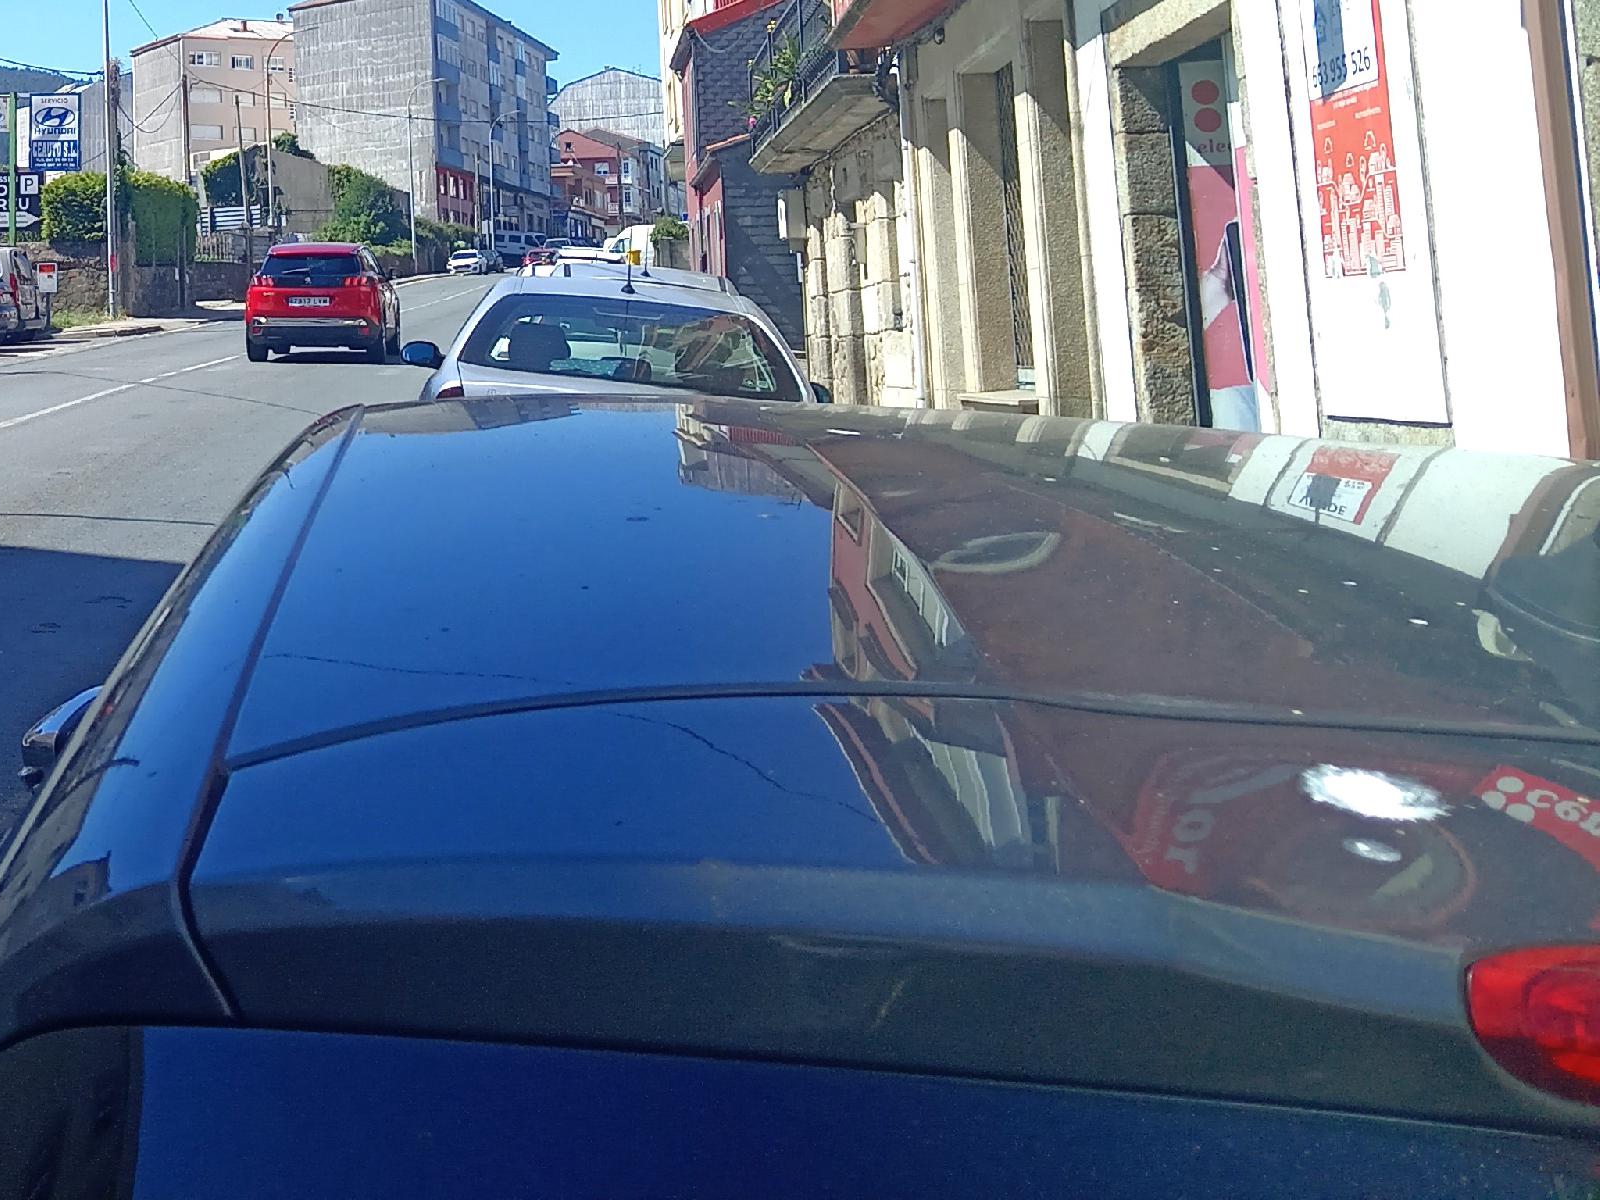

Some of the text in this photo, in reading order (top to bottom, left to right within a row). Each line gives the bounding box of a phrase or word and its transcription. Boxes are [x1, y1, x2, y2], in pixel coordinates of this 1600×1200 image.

[1330, 53, 1347, 82] 955
[1351, 46, 1371, 75] 526
[34, 127, 76, 135] HYUNDAI
